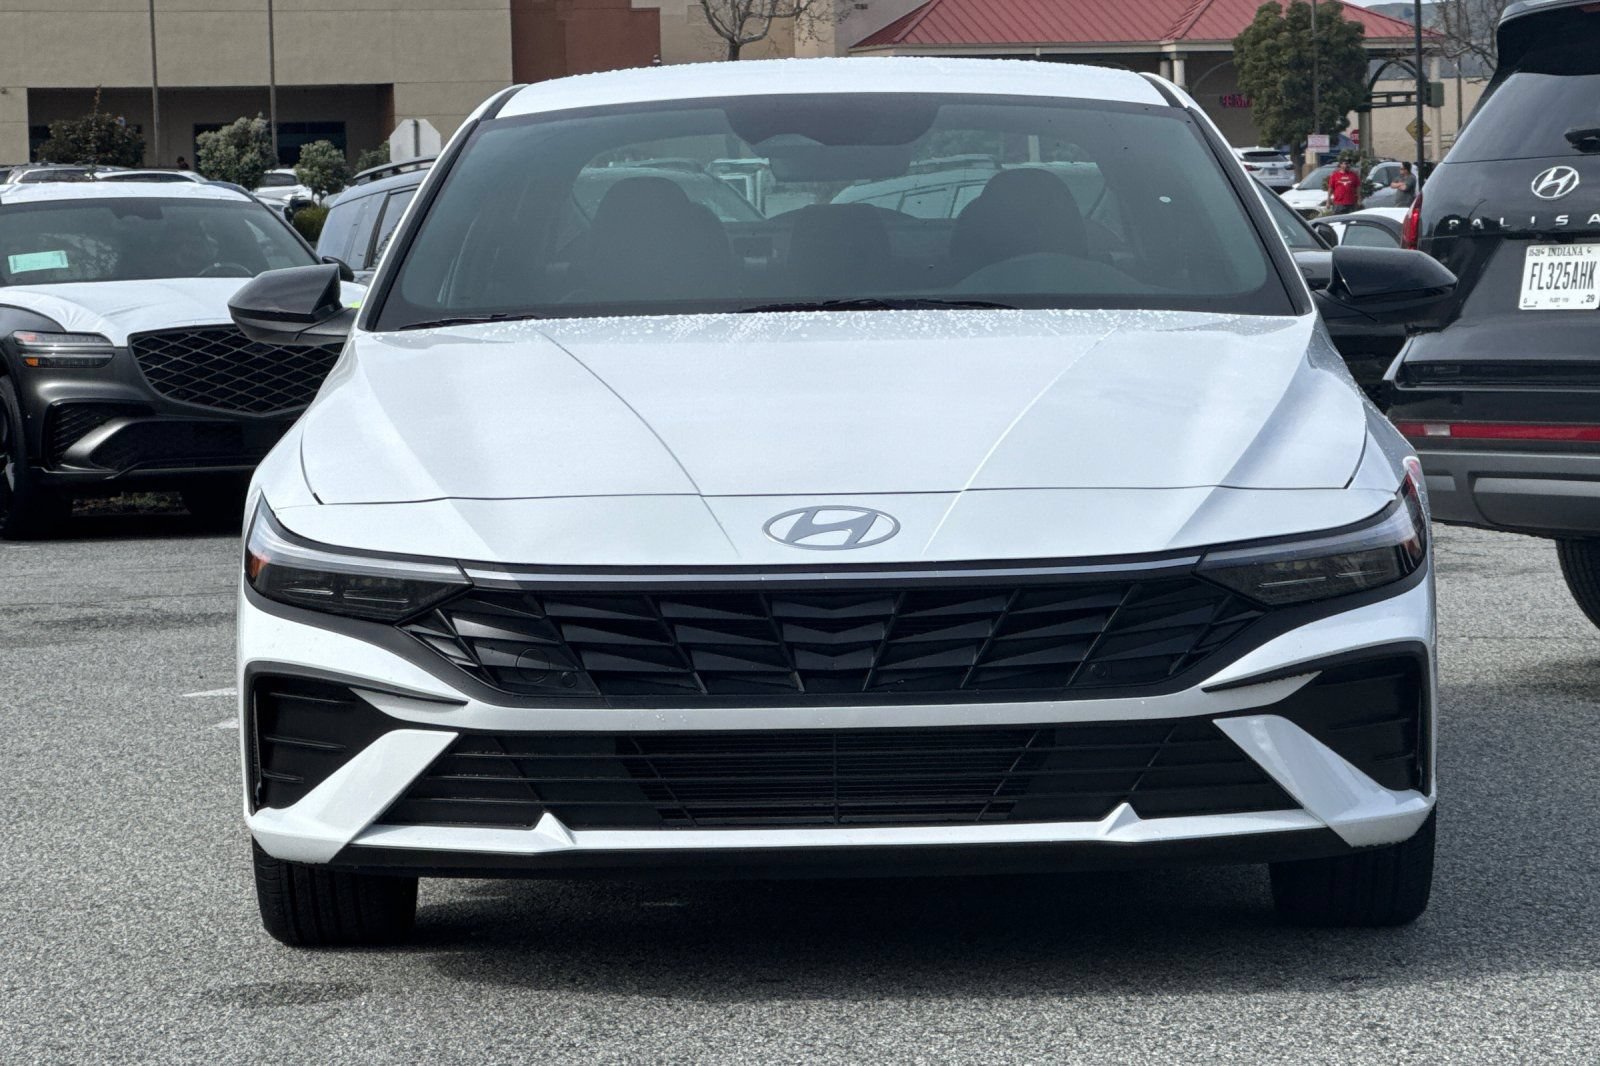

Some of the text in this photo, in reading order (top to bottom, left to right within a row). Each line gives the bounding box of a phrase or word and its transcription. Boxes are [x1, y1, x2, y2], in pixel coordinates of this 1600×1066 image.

[1548, 246, 1584, 257] INDIANA
[1529, 261, 1597, 290] FL325AHK
[1585, 294, 1596, 303] 29
